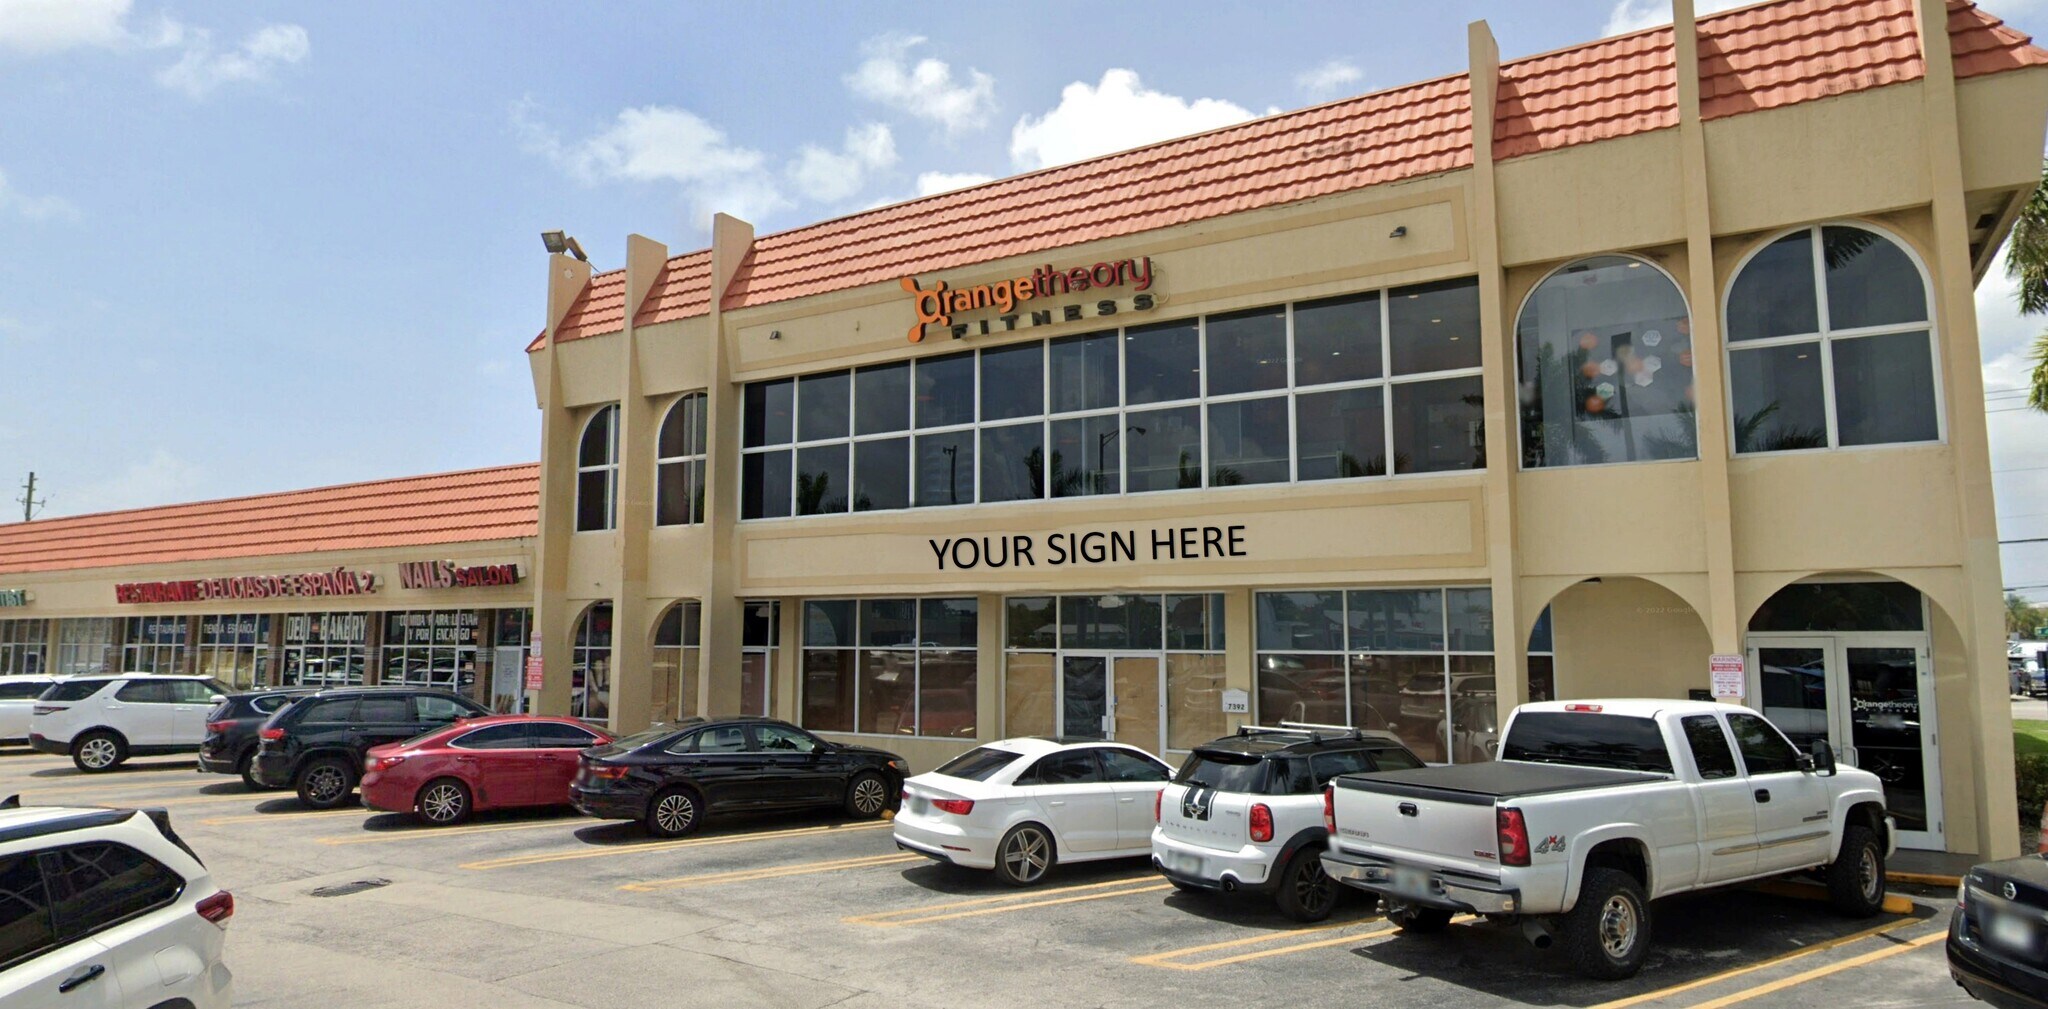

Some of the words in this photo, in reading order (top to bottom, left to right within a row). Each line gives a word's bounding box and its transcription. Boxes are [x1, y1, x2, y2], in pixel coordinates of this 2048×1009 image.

[952, 294, 1154, 340] FITNESS
[115, 580, 203, 604] RESTAURANTE
[203, 576, 266, 599] DELICIAS
[267, 575, 291, 598] DE
[291, 567, 360, 597] ESPAÑA
[361, 571, 375, 594] 2
[398, 559, 455, 589] NAILS
[456, 564, 518, 588] SALON
[148, 624, 187, 635] RETAURANTE
[203, 623, 224, 635] TIENA
[227, 621, 257, 634] ESAÑOLA
[287, 616, 311, 640] DELI
[320, 614, 367, 640] BAKERY
[409, 628, 414, 640] Y
[415, 628, 430, 640] POR
[436, 628, 470, 640] ENCARGO
